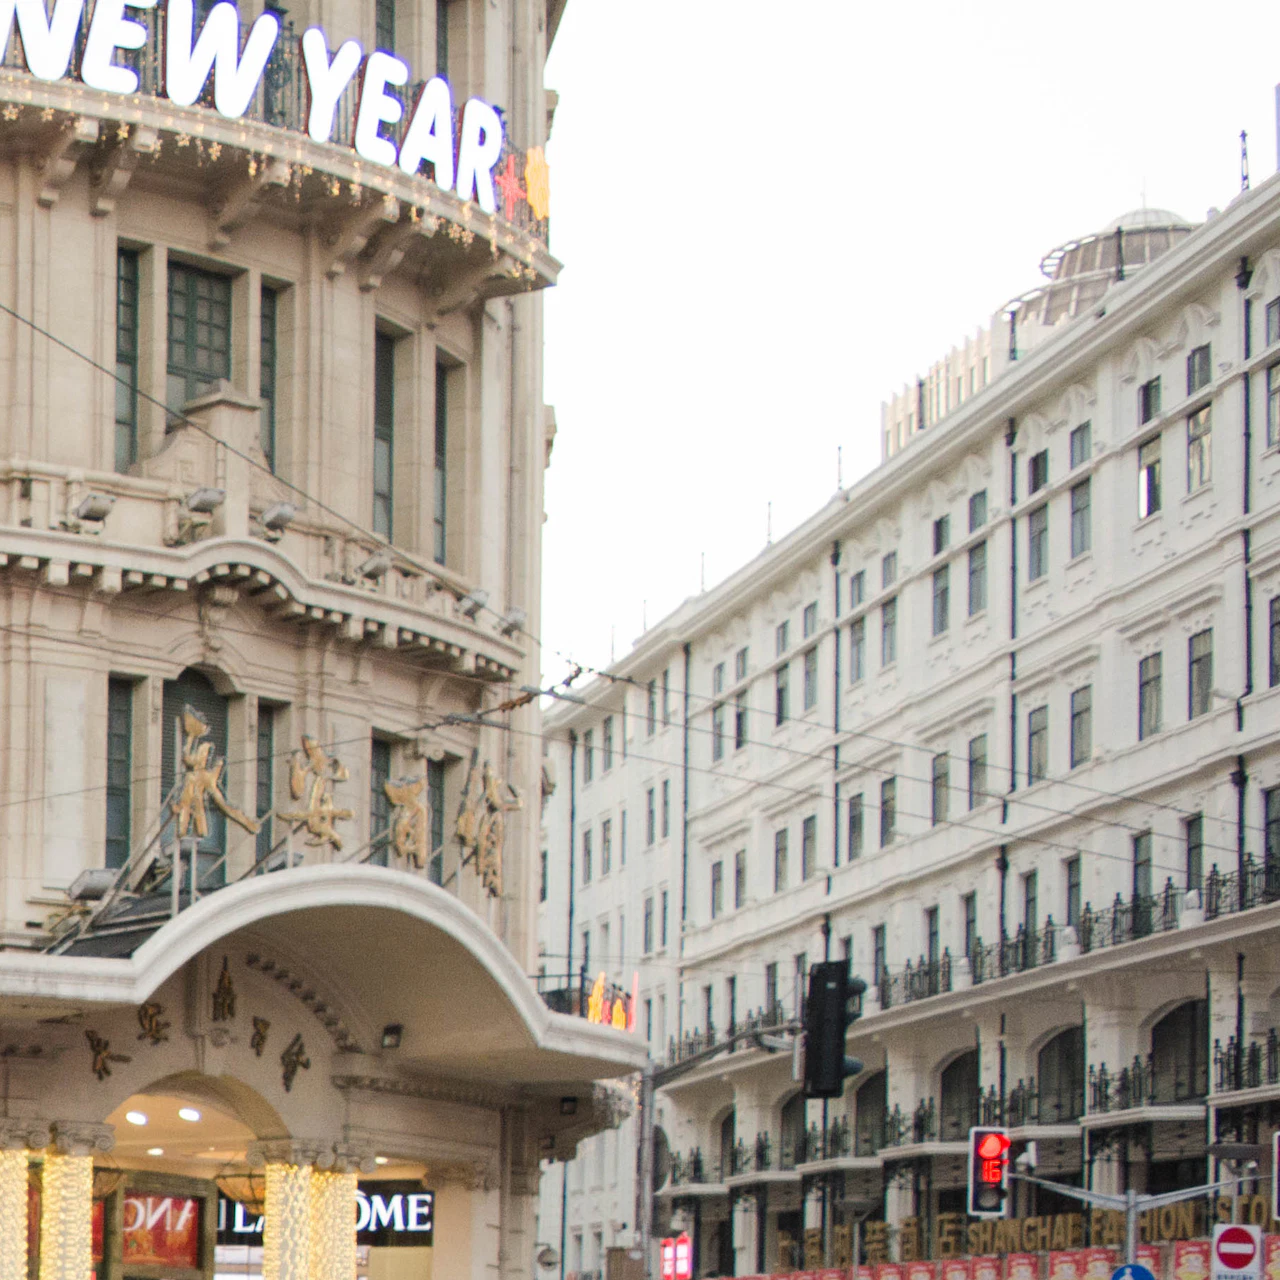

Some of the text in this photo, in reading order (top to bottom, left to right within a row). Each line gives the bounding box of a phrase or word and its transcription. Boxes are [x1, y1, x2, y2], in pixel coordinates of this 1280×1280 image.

[302, 26, 504, 215] YEAR
[982, 1160, 1003, 1183] 16
[1090, 1200, 1196, 1248] FAHION
